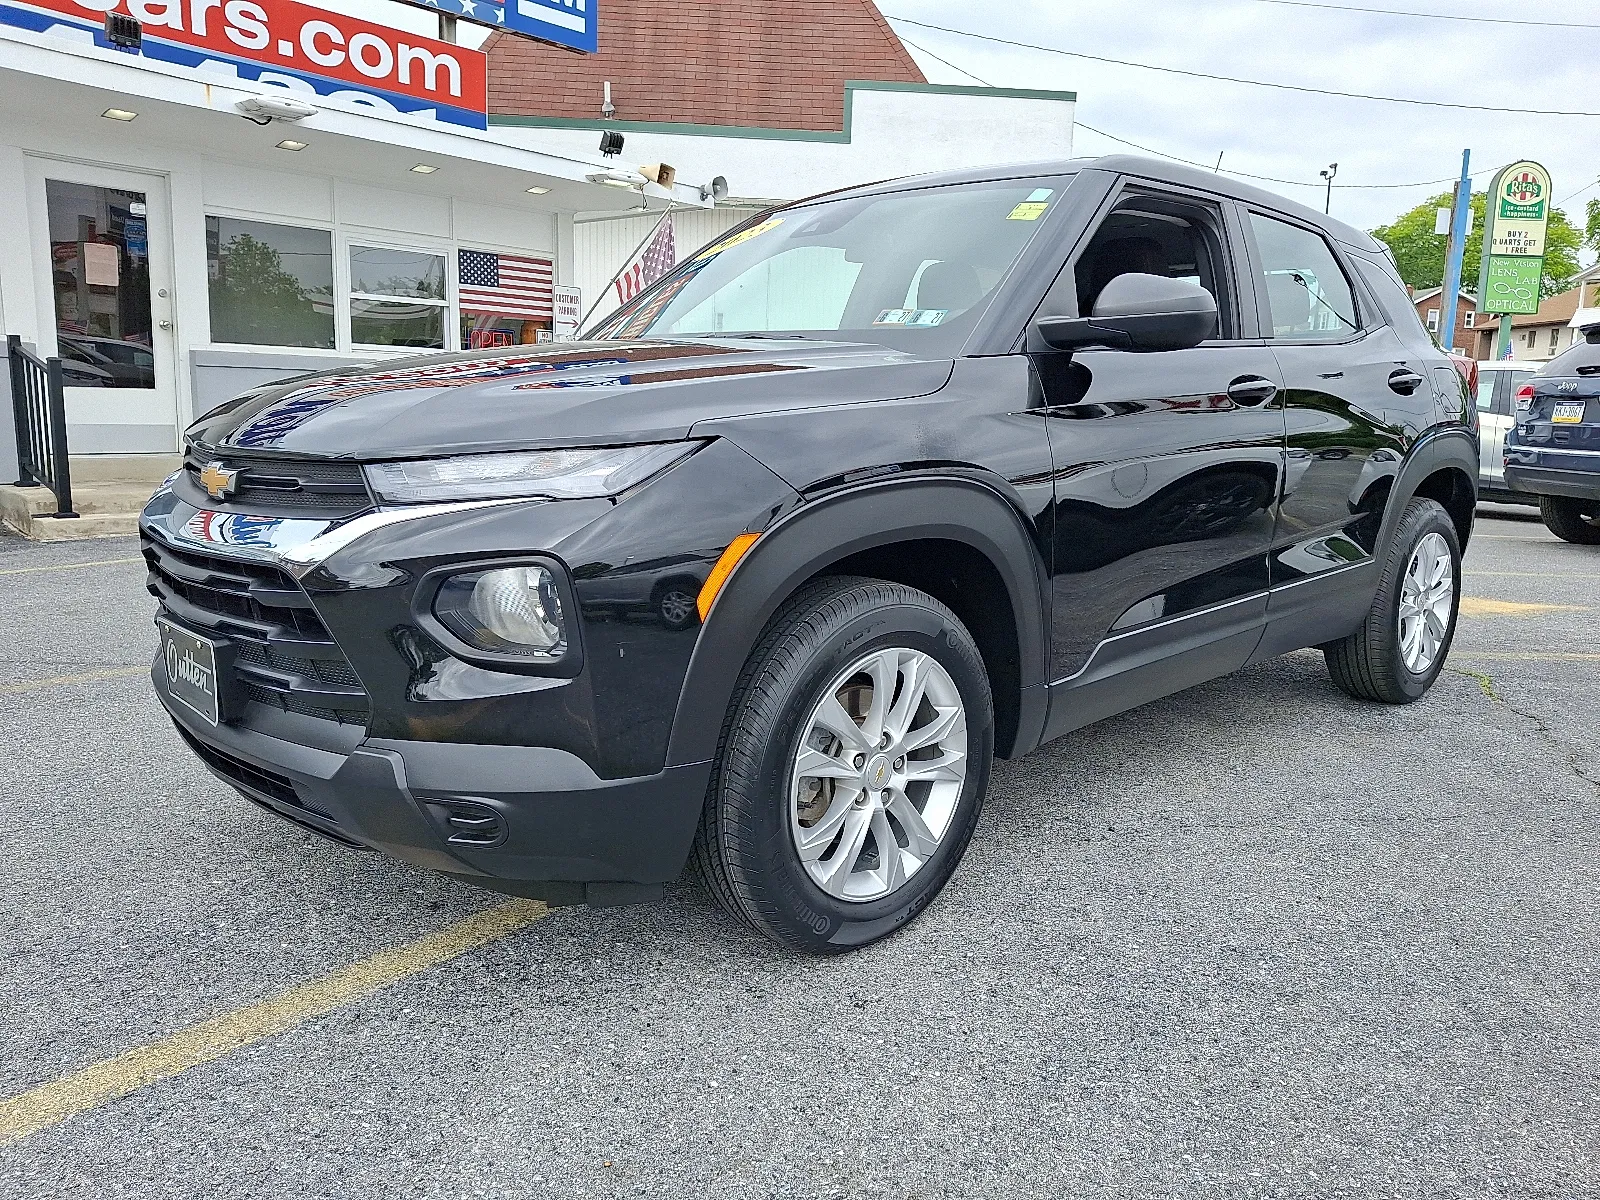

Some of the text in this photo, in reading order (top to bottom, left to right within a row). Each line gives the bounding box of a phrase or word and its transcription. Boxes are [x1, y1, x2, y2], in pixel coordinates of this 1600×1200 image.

[72, 0, 463, 98] ars.com
[1510, 181, 1539, 194] Rita's
[1507, 230, 1523, 238] BUY
[1523, 239, 1537, 247] GET
[1492, 258, 1539, 268] New Vision
[1491, 267, 1518, 277] LENS
[1515, 276, 1538, 285] LAB
[555, 293, 580, 305] CUSTOMER
[1486, 299, 1535, 311] OPTICAL
[558, 305, 578, 317] PARKING
[470, 330, 513, 349] OPEN
[1557, 381, 1578, 392] Jeep
